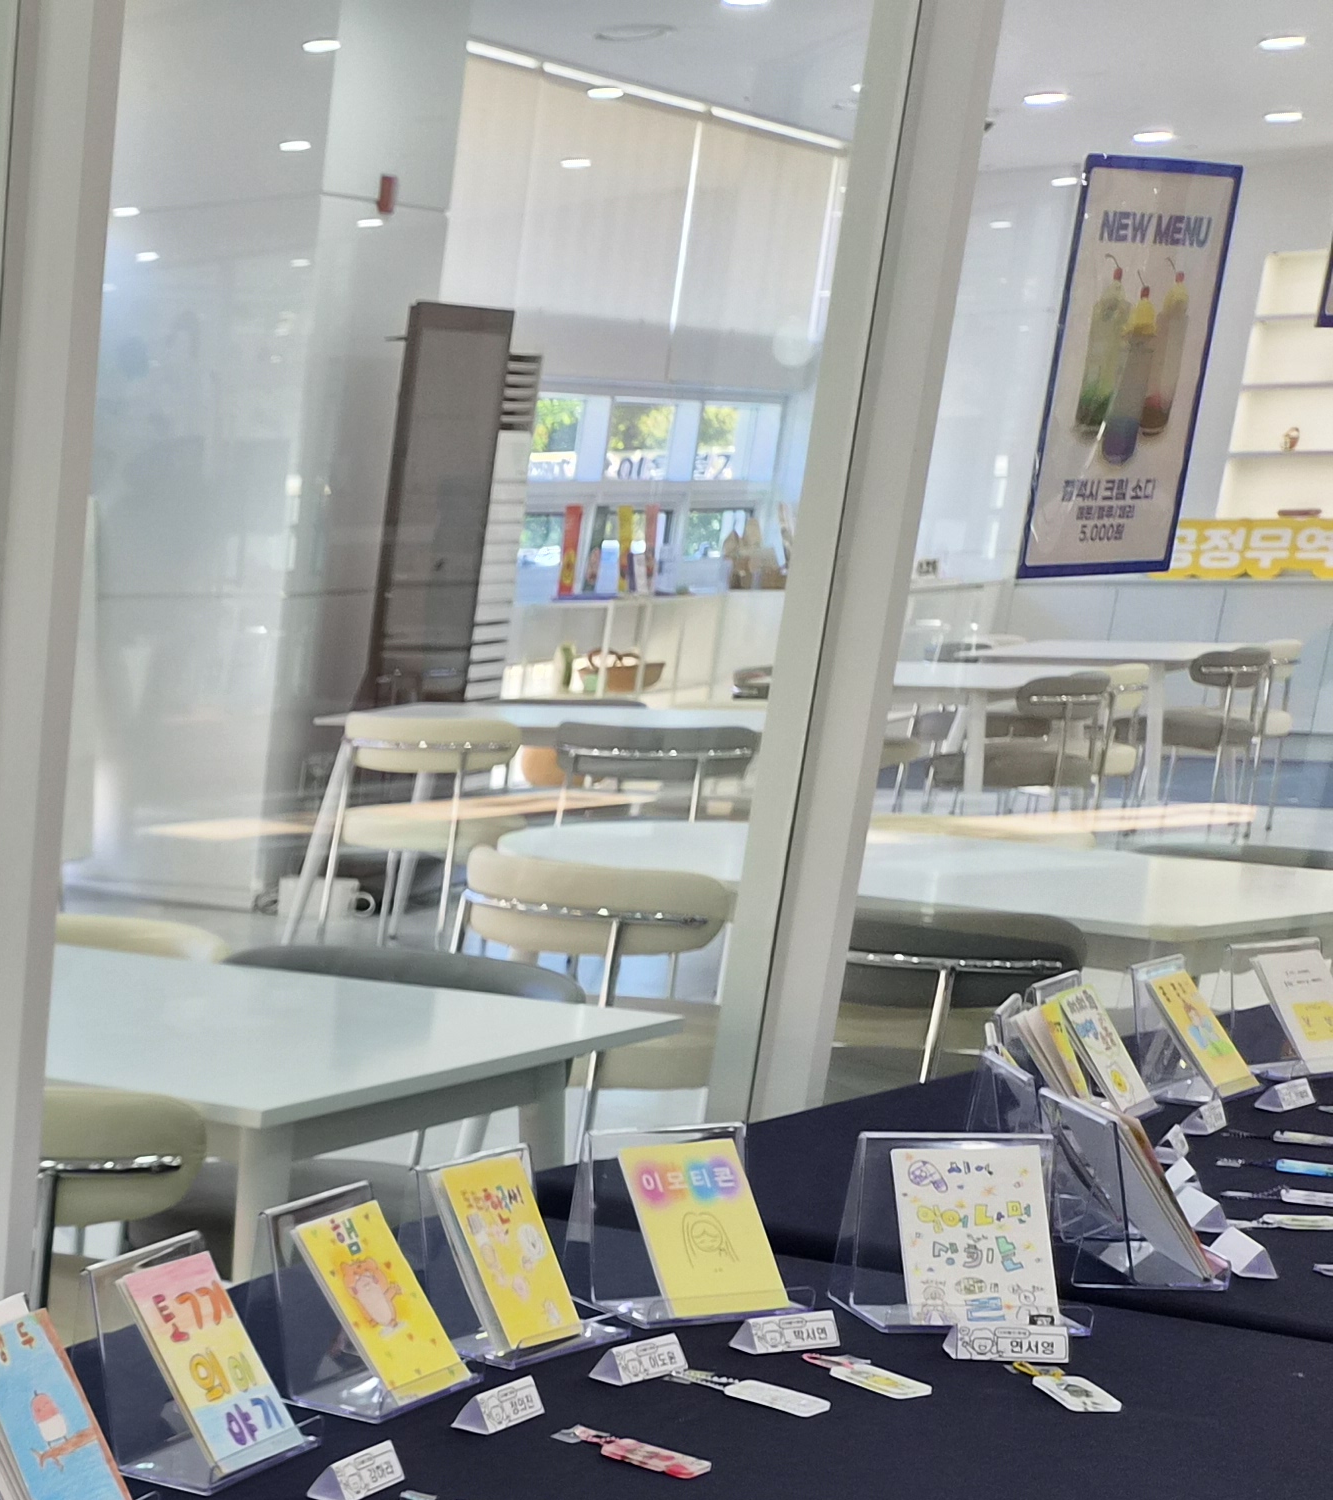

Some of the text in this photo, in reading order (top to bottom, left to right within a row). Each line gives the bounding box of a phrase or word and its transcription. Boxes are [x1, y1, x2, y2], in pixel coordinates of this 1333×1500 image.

[1098, 209, 1212, 248] NEW MENU
[642, 1167, 736, 1192] 이모티콘
